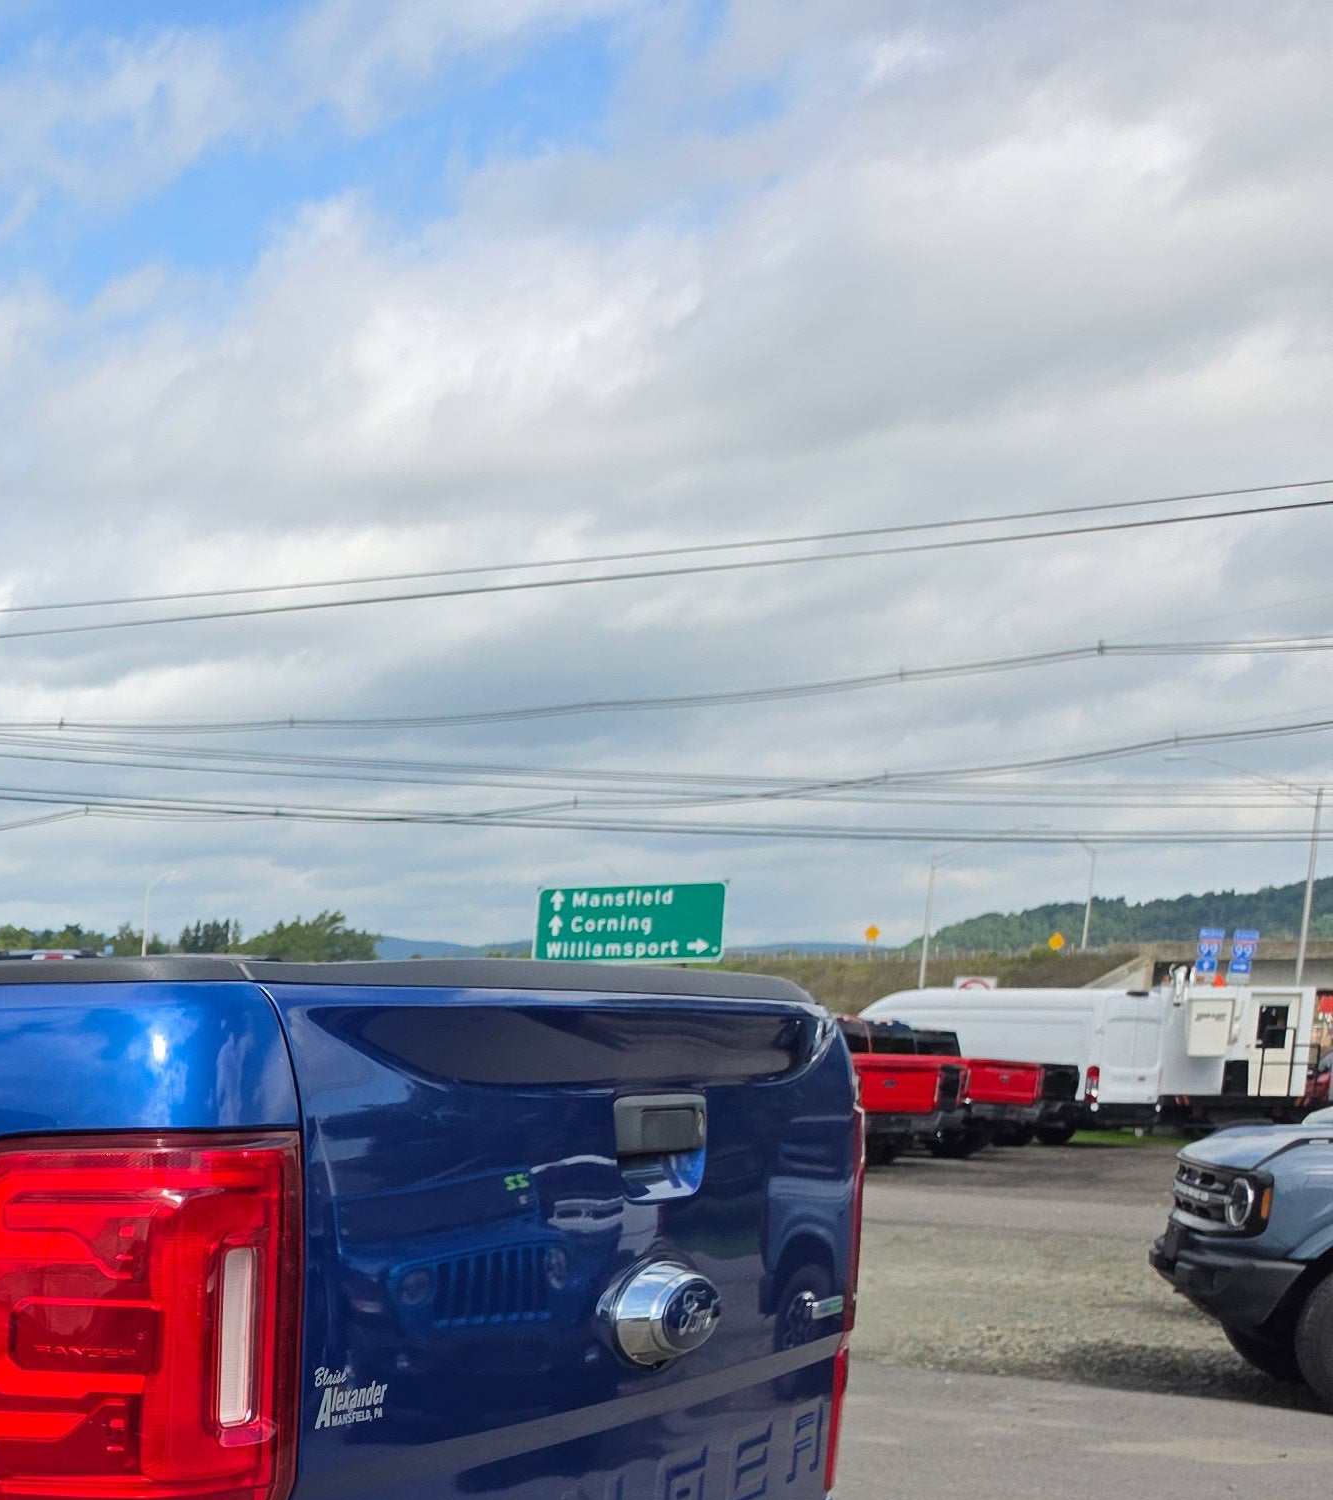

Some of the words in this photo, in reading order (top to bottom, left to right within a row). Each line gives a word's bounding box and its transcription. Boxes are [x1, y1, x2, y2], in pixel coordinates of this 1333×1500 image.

[572, 888, 675, 908] Mansfield
[570, 915, 653, 936] Corning
[546, 939, 679, 959] Williamsport
[678, 1289, 721, 1337] Ford
[314, 1366, 348, 1388] Blaise
[314, 1380, 388, 1430] Alexander
[373, 1406, 384, 1419] PA
